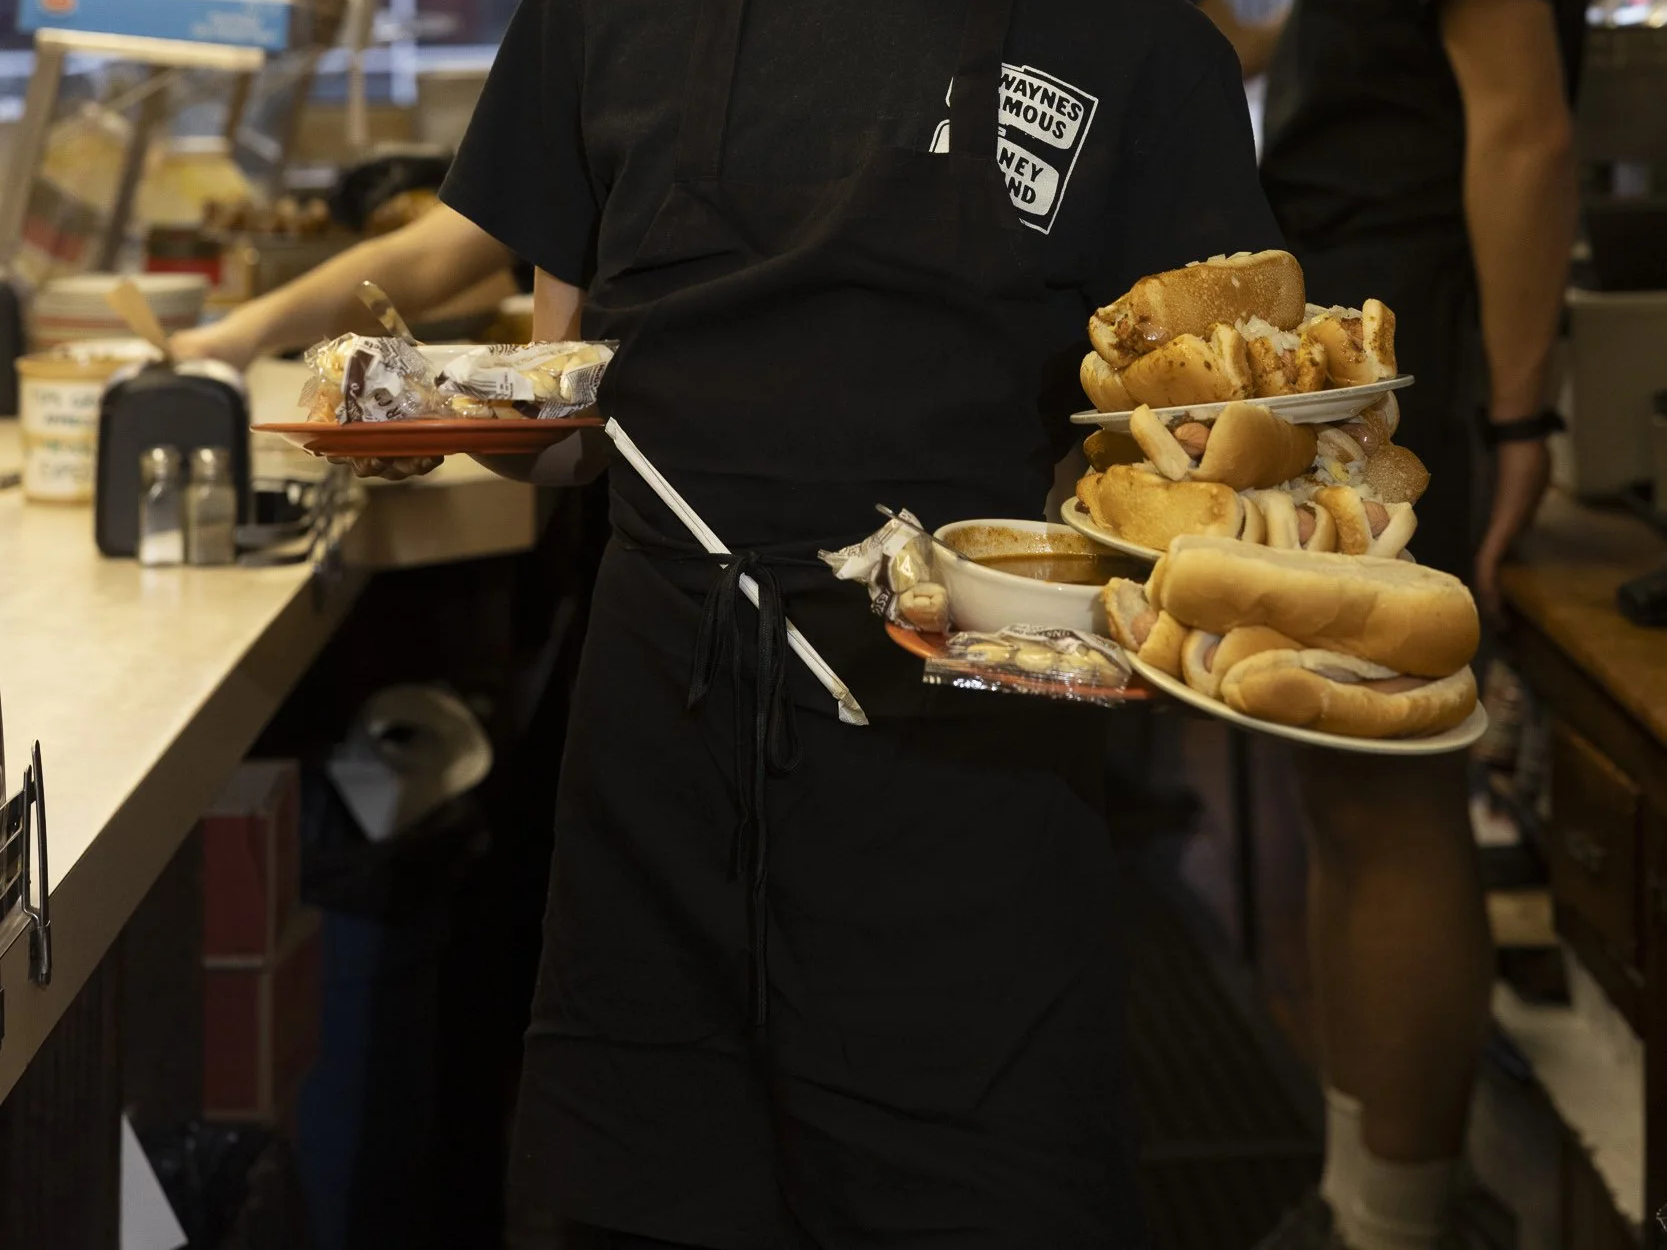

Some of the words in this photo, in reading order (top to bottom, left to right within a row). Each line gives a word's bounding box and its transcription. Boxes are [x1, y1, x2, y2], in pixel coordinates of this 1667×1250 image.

[999, 73, 1083, 122] WAYNES
[1002, 96, 1067, 140] MOUS
[998, 146, 1044, 183] NEY
